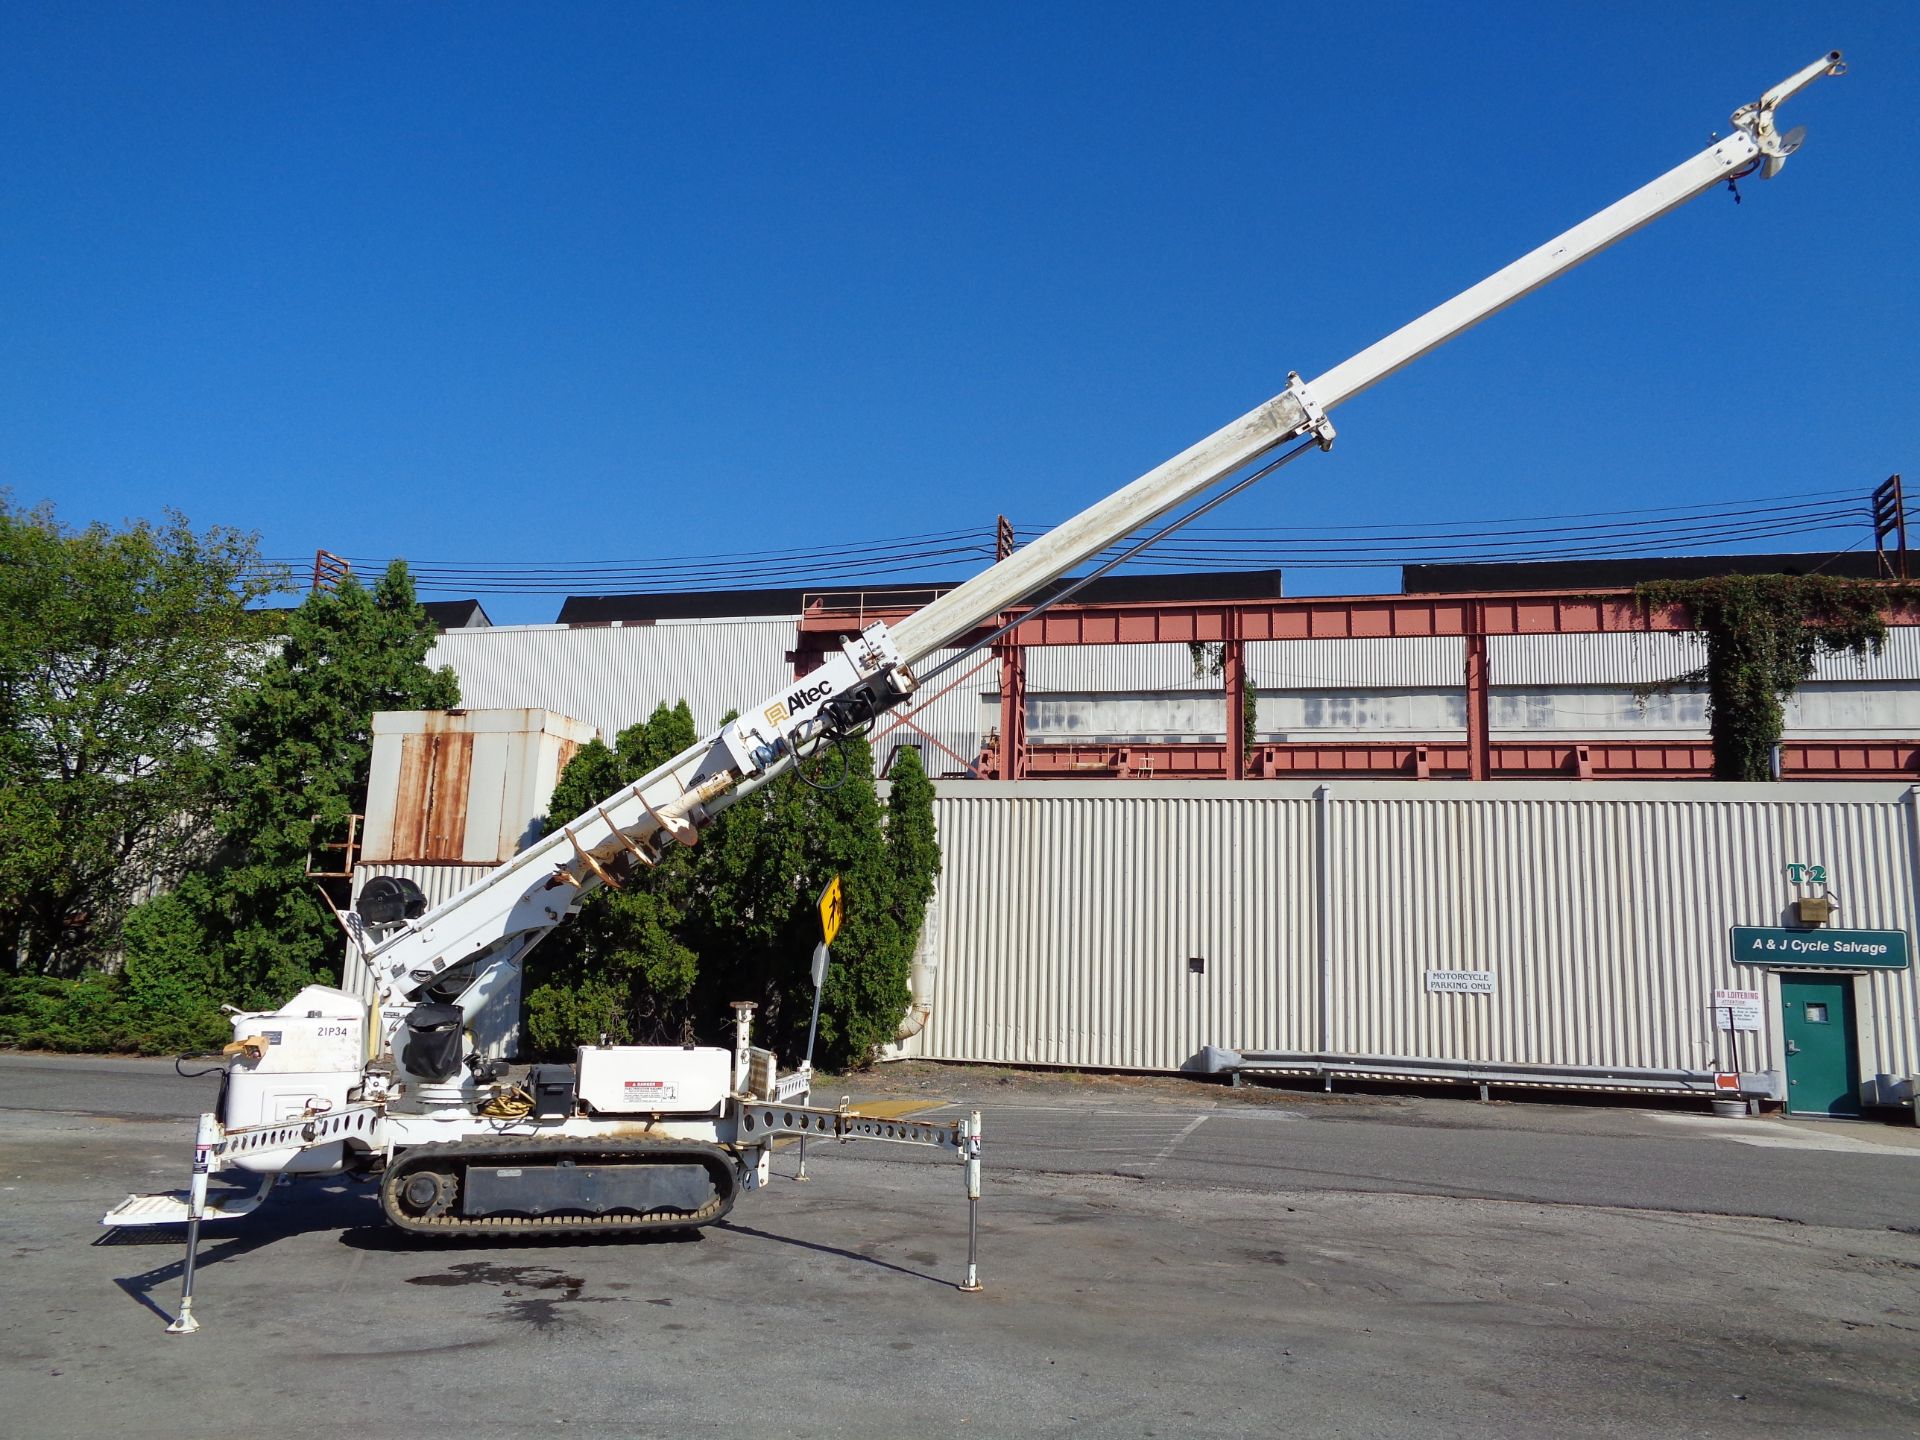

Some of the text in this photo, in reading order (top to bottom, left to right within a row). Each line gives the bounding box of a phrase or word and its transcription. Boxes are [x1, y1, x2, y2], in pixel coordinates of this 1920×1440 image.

[787, 680, 832, 716] Altec
[1786, 863, 1827, 883] T2
[1752, 938, 1888, 956] A & J Cycle Salvage
[1432, 972, 1489, 981] MOTORCYCLE
[1430, 981, 1492, 990] PARKING ONLY
[1716, 990, 1759, 1000] NO LOITERING
[317, 1026, 348, 1037] 21P34
